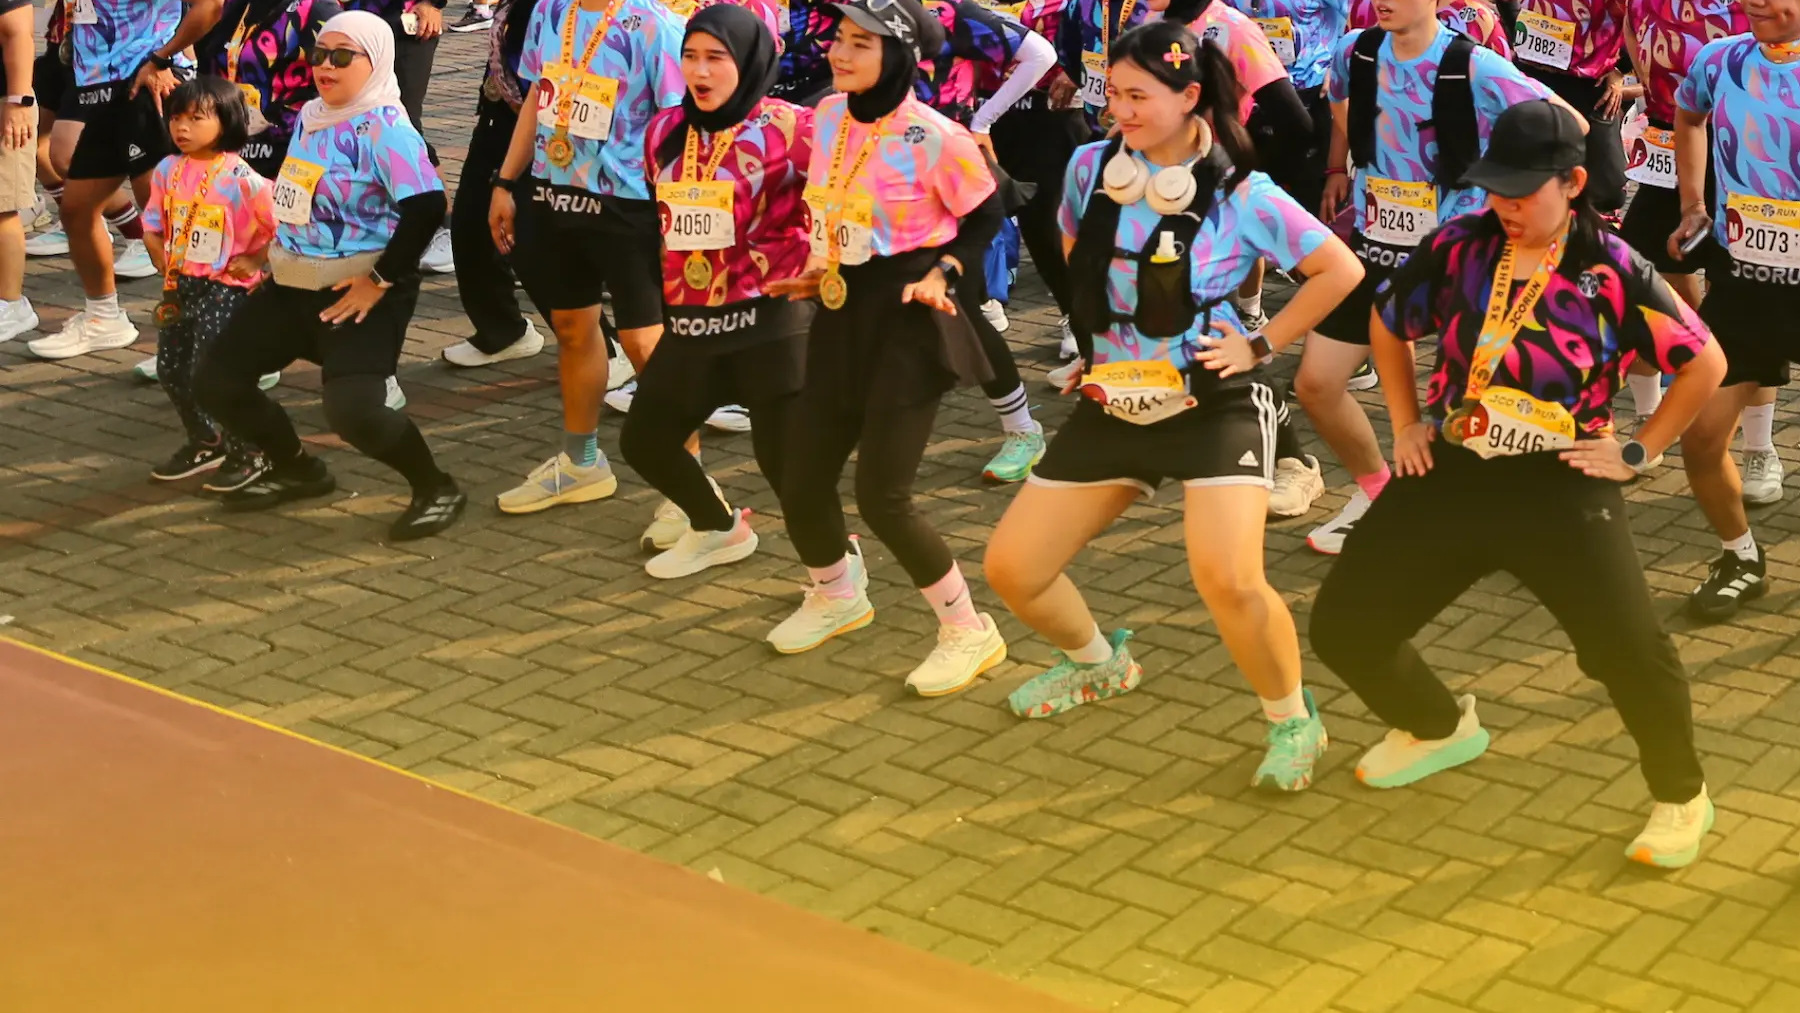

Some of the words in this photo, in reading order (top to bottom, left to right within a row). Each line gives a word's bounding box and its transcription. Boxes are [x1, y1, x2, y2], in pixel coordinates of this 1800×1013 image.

[1527, 18, 1540, 26] JCO
[1550, 23, 1564, 32] RUN
[1528, 33, 1556, 57] 7882
[1562, 33, 1572, 41] 5K
[582, 30, 603, 68] JCORUN
[1088, 76, 1106, 96] 73
[538, 90, 550, 109] M
[1633, 148, 1643, 164] F
[1646, 151, 1672, 176] 455
[668, 191, 686, 199] JCO
[1375, 186, 1390, 194] JCO
[1403, 190, 1420, 198] RUN
[1380, 208, 1415, 232] 6243
[1740, 204, 1760, 214] JCO
[1776, 208, 1798, 218] RUN
[209, 219, 220, 229] 5K
[674, 213, 712, 236] 4050
[1728, 223, 1740, 241] M
[1744, 225, 1790, 253] 2073
[1356, 243, 1410, 268] JCOR
[1510, 280, 1541, 330] JCORUN
[1488, 394, 1514, 407] JCO
[1534, 408, 1559, 421] RUN
[1469, 417, 1481, 434] F
[1488, 423, 1544, 452] 9446
